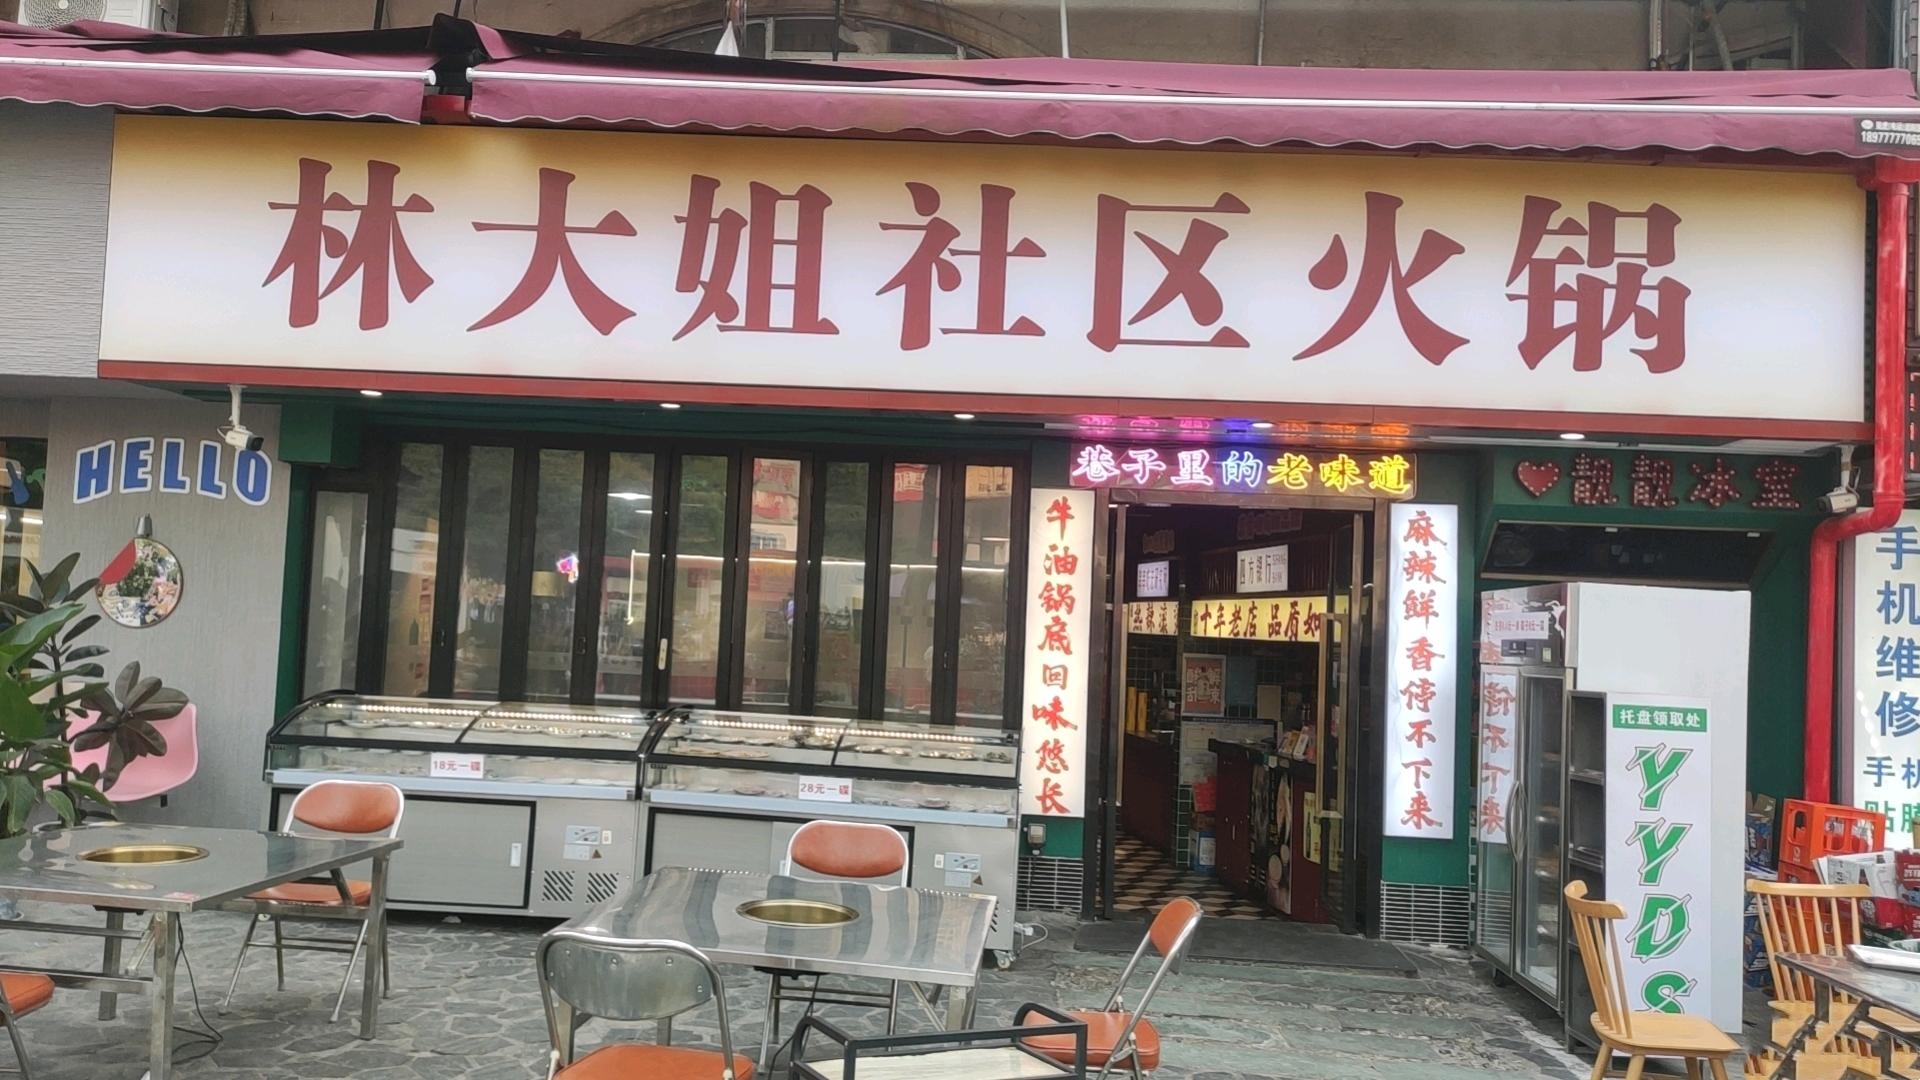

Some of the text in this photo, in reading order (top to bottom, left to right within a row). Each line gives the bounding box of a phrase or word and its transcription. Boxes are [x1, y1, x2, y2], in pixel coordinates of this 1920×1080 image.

[262, 157, 1692, 373] 林大姐社区火锅
[72, 437, 272, 506] HELLO
[1071, 445, 1412, 493] 巷子里的老味道
[1032, 496, 1078, 815] 牛油锅底回味悠长
[1399, 510, 1447, 829] 麻辣鲜香停不下来
[1619, 708, 1701, 728] 托盘领取处
[1875, 526, 1920, 737] 手机维修
